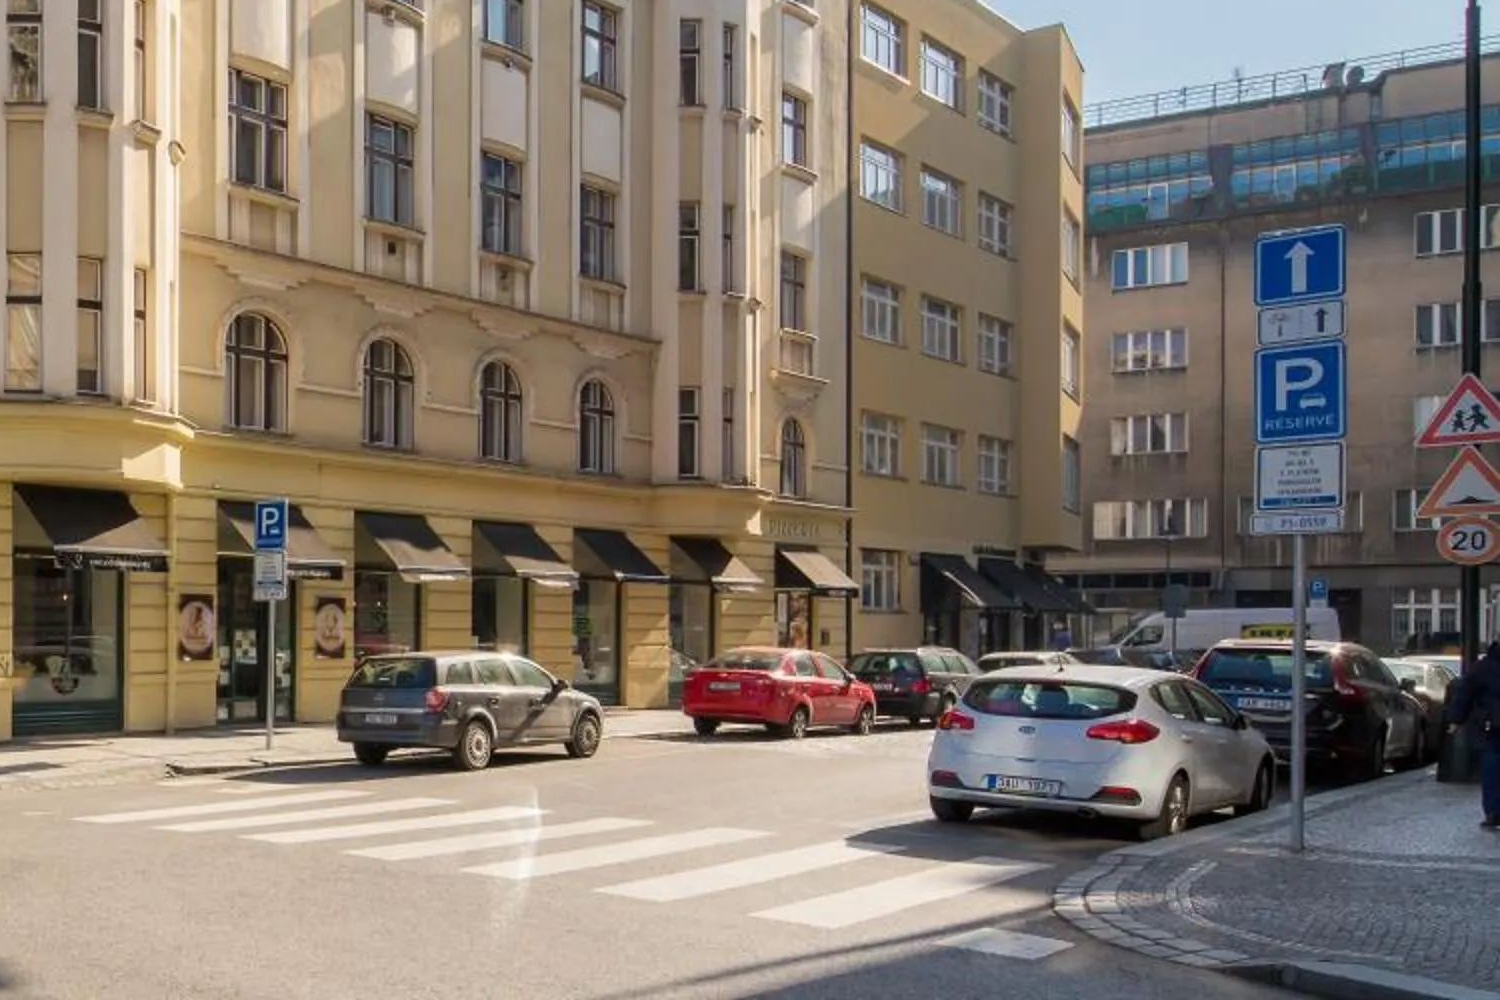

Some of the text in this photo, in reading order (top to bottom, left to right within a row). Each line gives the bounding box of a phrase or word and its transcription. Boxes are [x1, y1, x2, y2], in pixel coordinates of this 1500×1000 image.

[1275, 357, 1324, 411] P
[261, 507, 280, 536] P
[1451, 530, 1486, 551] 20
